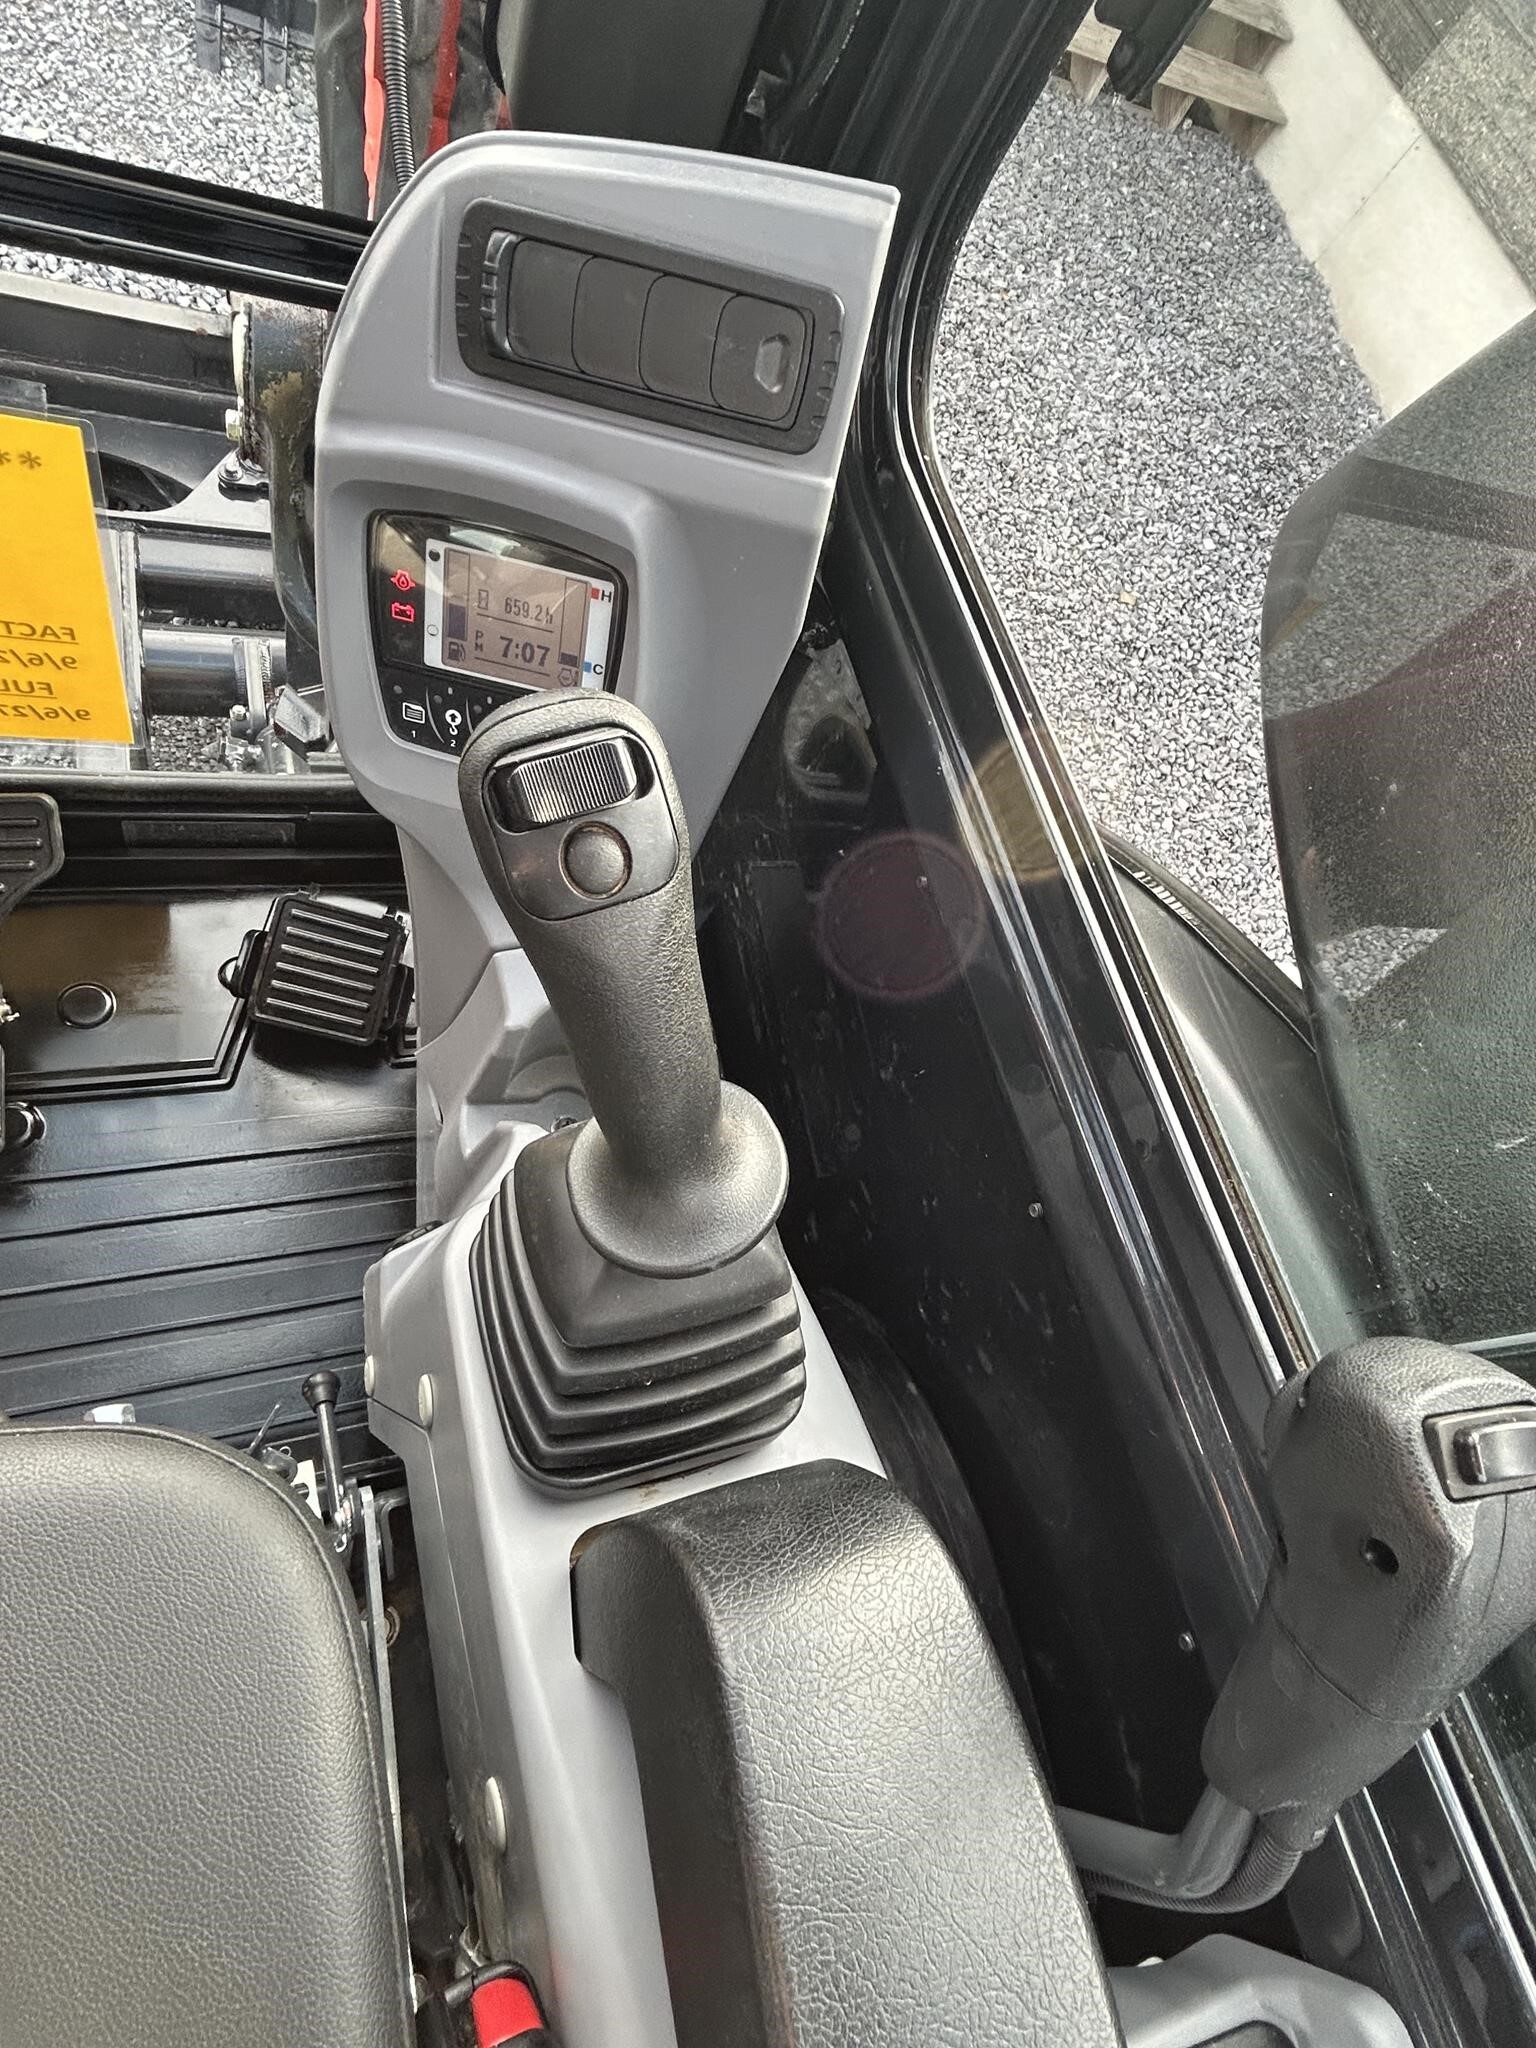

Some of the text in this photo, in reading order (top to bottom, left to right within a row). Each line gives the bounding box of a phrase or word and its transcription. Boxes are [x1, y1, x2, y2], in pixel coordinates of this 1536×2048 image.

[600, 589, 612, 603] H
[499, 635, 550, 667] 7:07
[592, 663, 604, 675] C
[450, 739, 456, 747] 2
